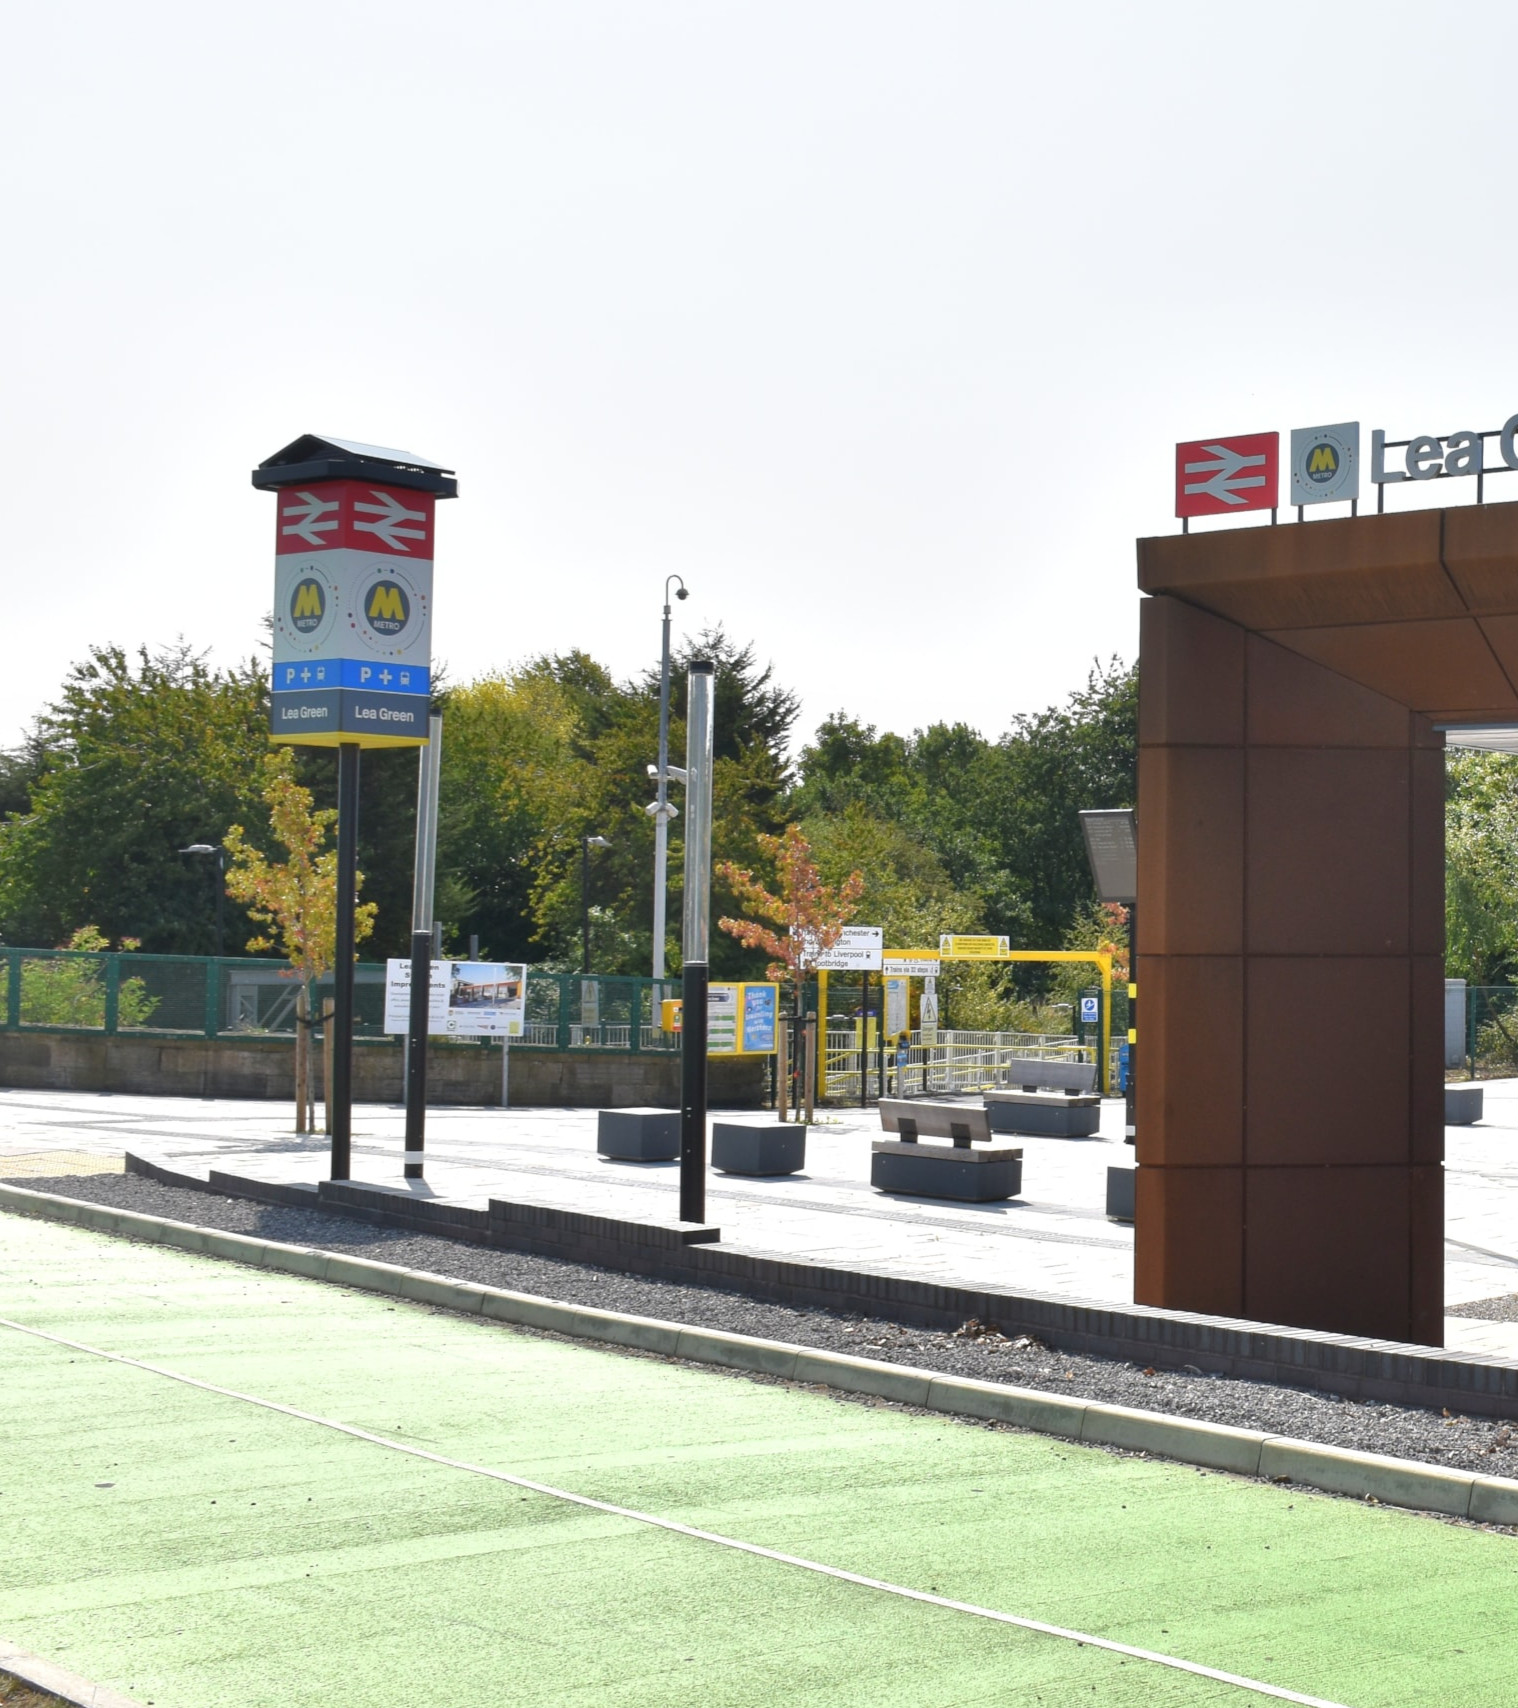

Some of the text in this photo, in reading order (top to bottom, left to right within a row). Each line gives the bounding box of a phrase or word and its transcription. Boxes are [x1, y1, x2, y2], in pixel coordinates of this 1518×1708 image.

[1371, 429, 1482, 484] Lea
[297, 619, 318, 628] METRO
[373, 620, 400, 630] METRO
[286, 668, 295, 684] P
[360, 667, 371, 682] P
[282, 707, 328, 719] Lea Green
[355, 706, 414, 722] Lea Green
[834, 951, 864, 959] Liverpool
